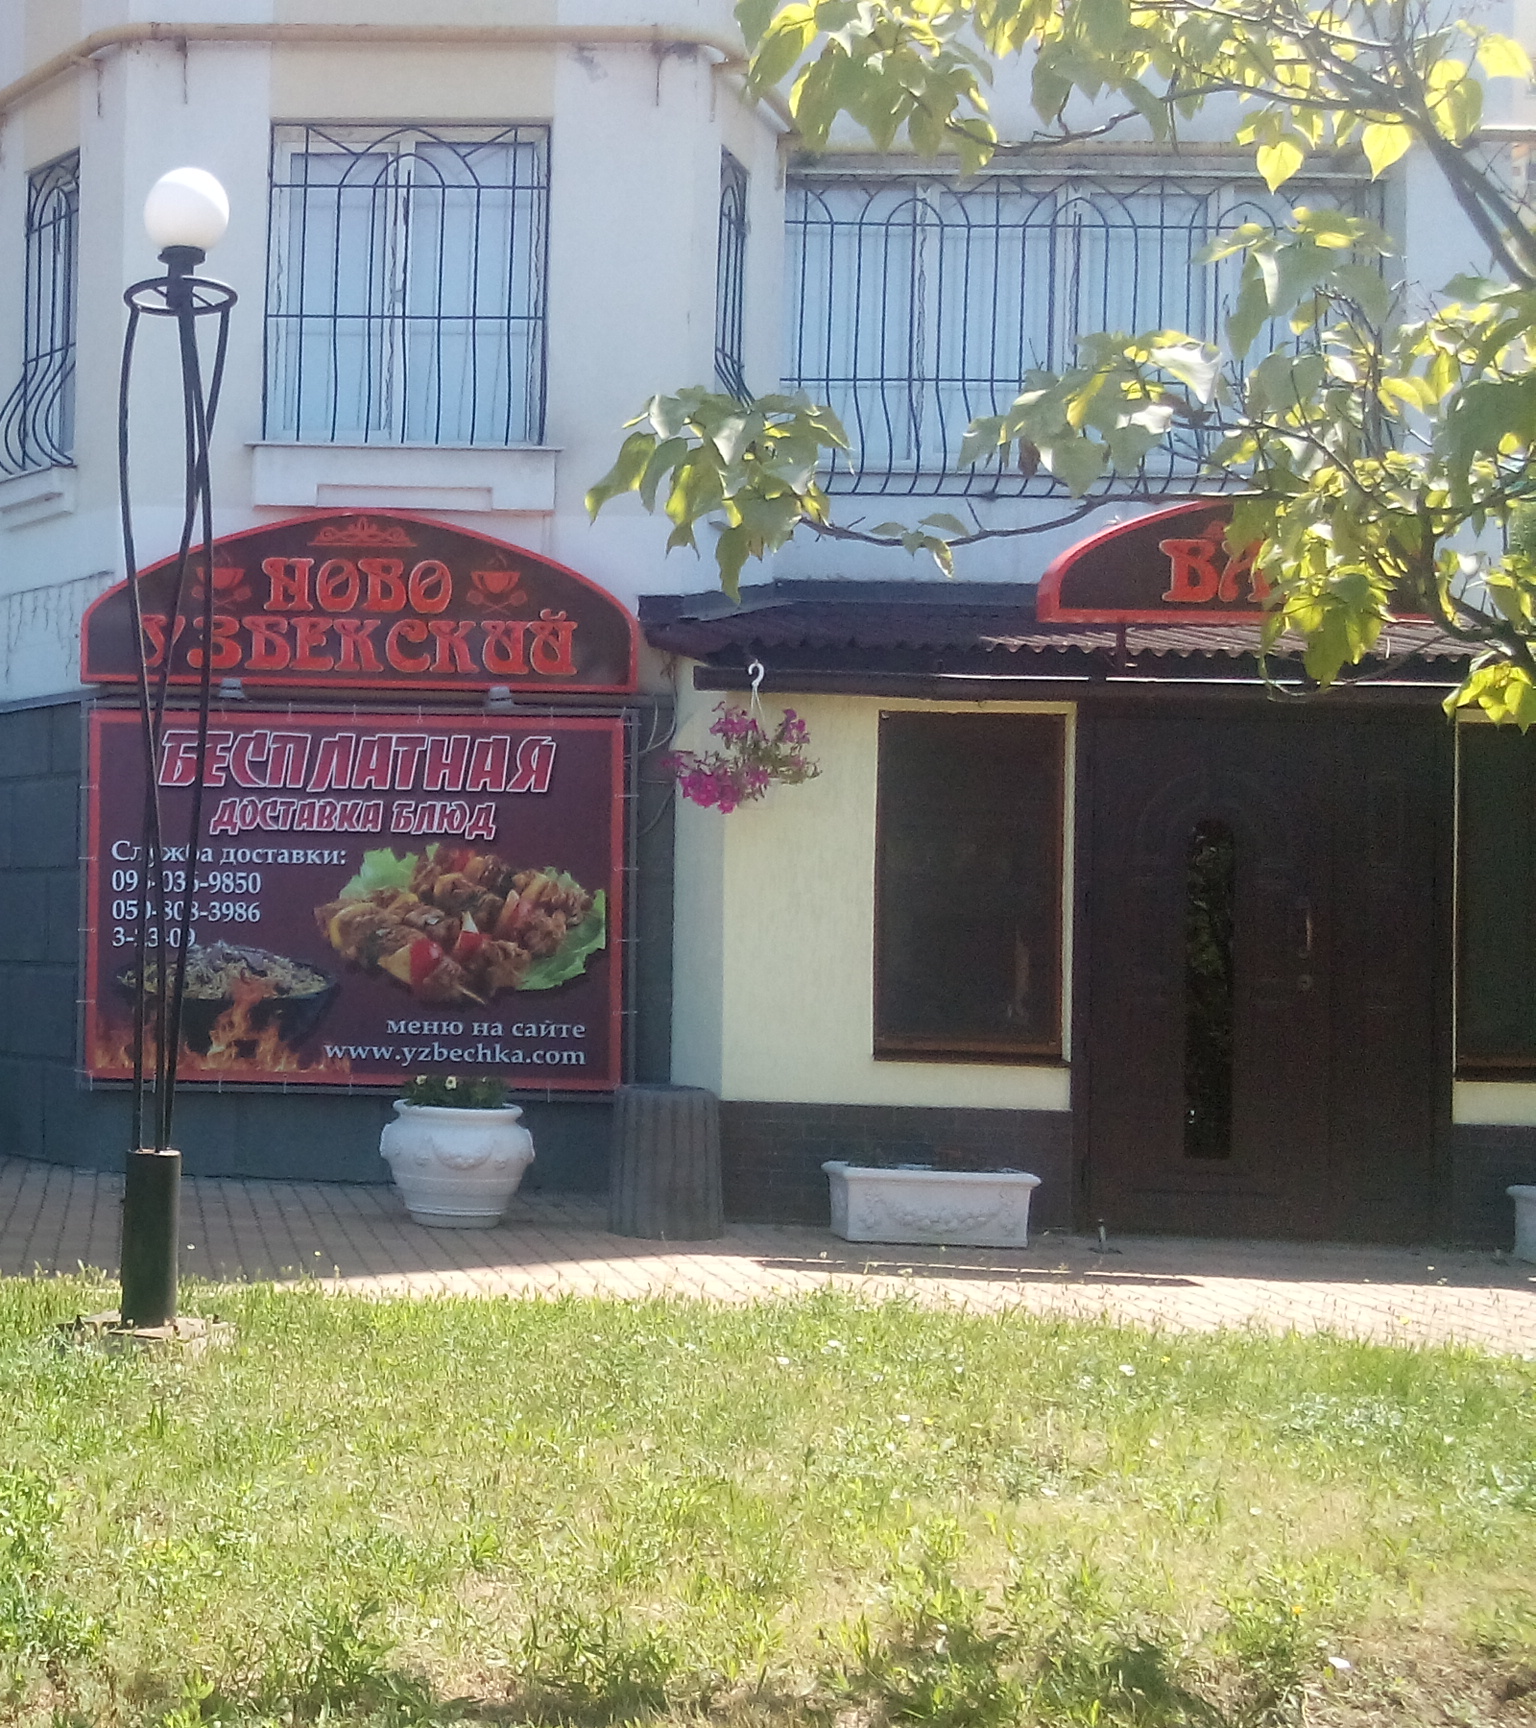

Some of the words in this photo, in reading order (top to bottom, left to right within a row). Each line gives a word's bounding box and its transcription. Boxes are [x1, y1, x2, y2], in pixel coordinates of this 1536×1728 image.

[262, 557, 453, 614] НОВО
[1159, 538, 1279, 603] BA
[141, 608, 578, 676] УЗБЕКСКИЙ
[158, 730, 557, 793] БЕСПЛАТНАЯ
[209, 797, 383, 835] ДОСТАВКА
[391, 800, 497, 840] БЛЮД
[219, 846, 347, 866] доставки:
[386, 1019, 464, 1036] меню
[472, 1021, 503, 1037] на
[512, 1019, 586, 1039] сайте
[323, 1042, 586, 1067] www.yzbechka.com
